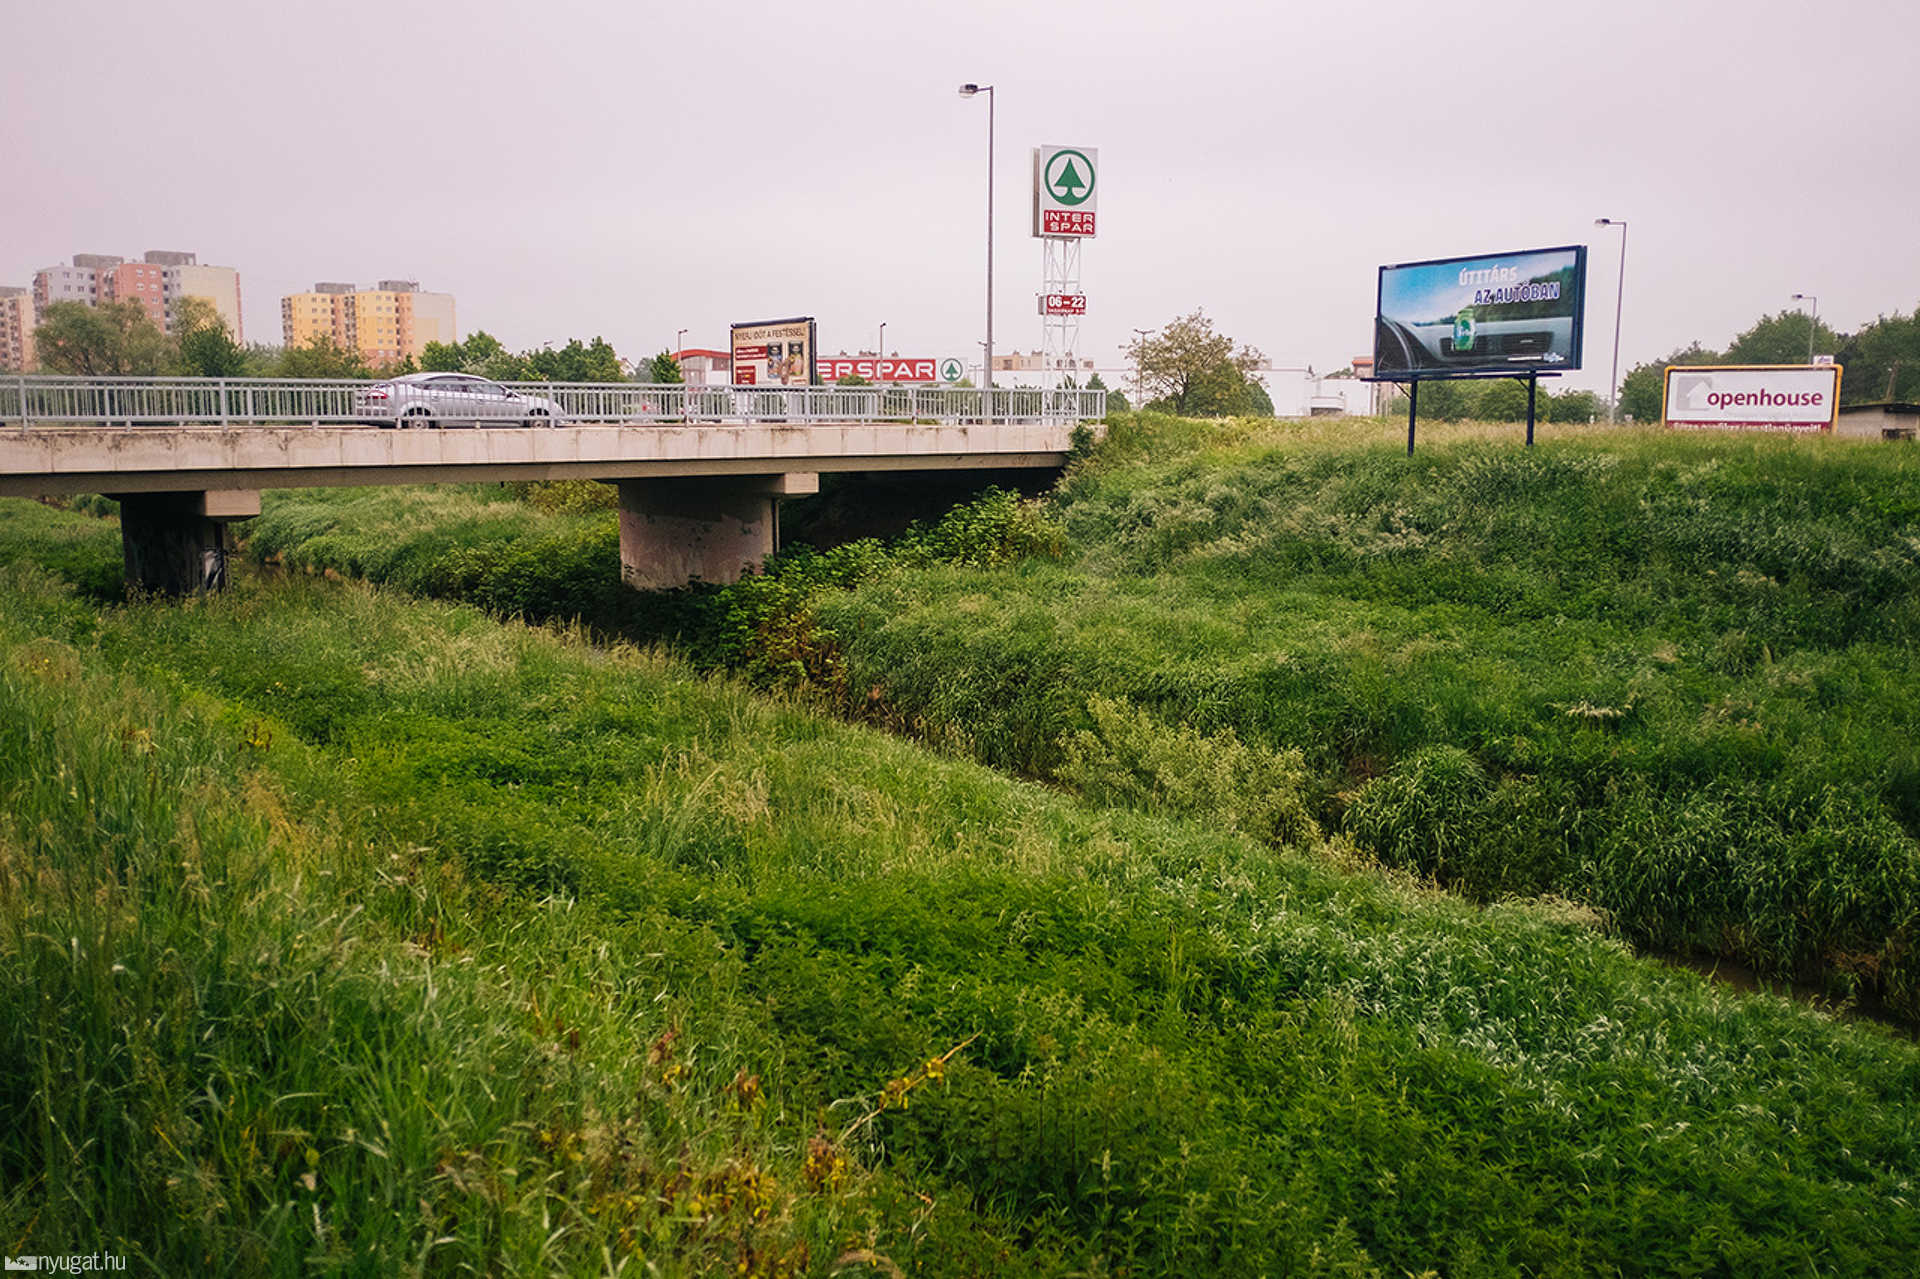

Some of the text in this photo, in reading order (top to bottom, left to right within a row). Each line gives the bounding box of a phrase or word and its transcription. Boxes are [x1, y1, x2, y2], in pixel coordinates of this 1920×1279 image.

[1045, 211, 1093, 223] INTER
[1050, 222, 1093, 233] SPAR
[1459, 264, 1518, 286] ÚTITÁRS
[1474, 288, 1492, 305] AZ
[1707, 388, 1823, 410] openhouse
